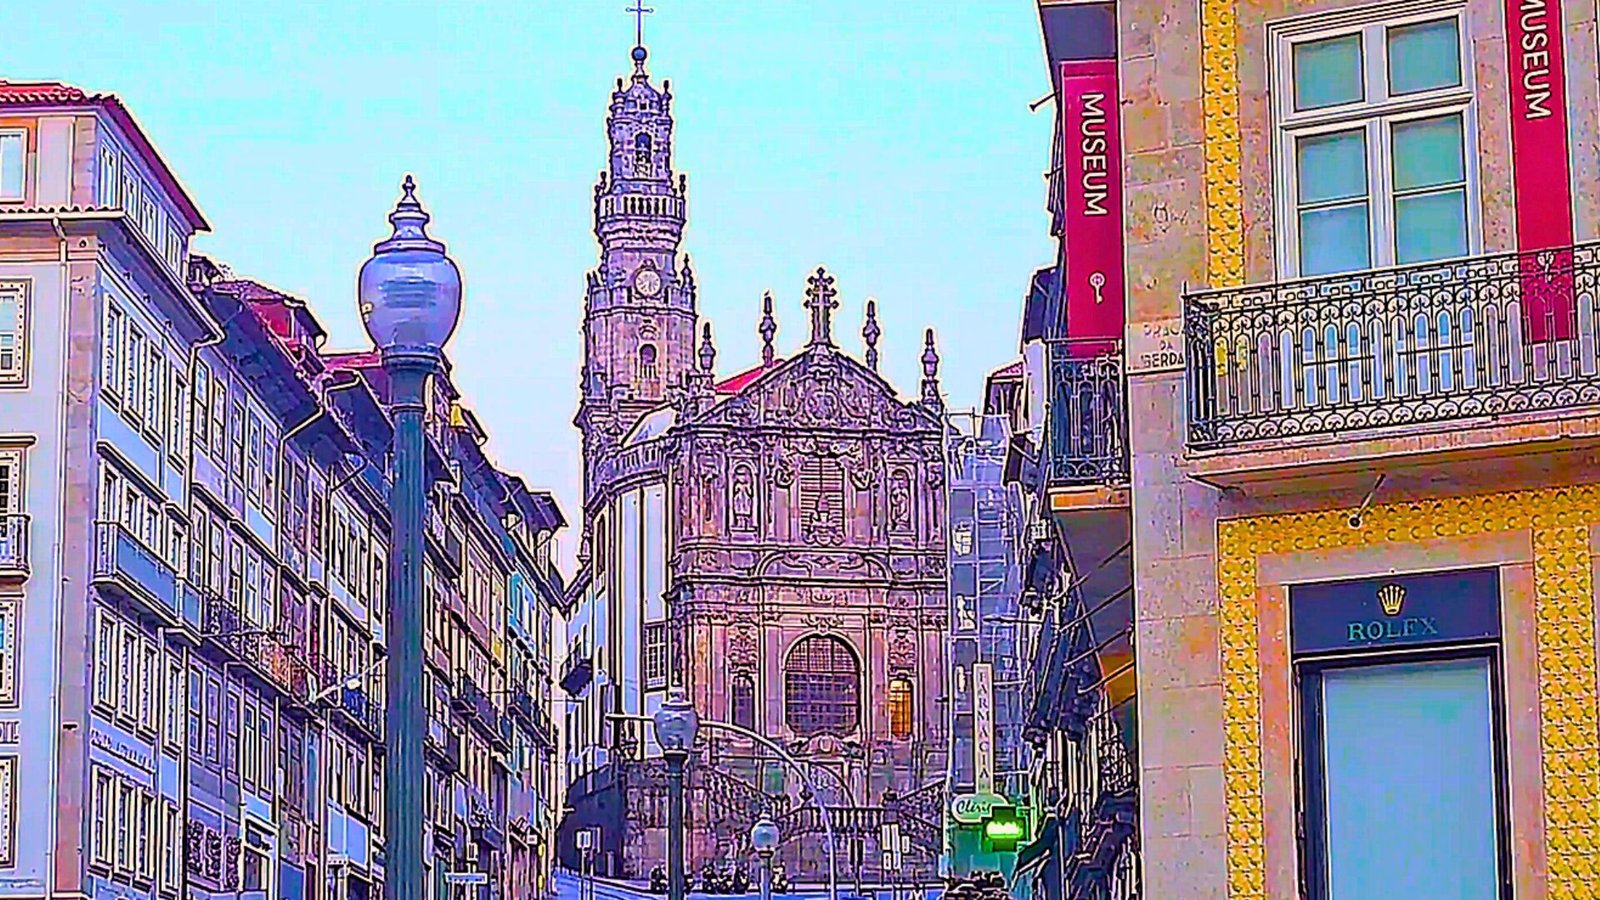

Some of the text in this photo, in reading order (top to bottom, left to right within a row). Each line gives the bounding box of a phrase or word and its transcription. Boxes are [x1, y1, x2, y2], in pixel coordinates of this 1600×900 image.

[1080, 92, 1108, 216] MUSEUM
[1347, 616, 1438, 641] ROLEX
[977, 671, 990, 779] FARMACIA
